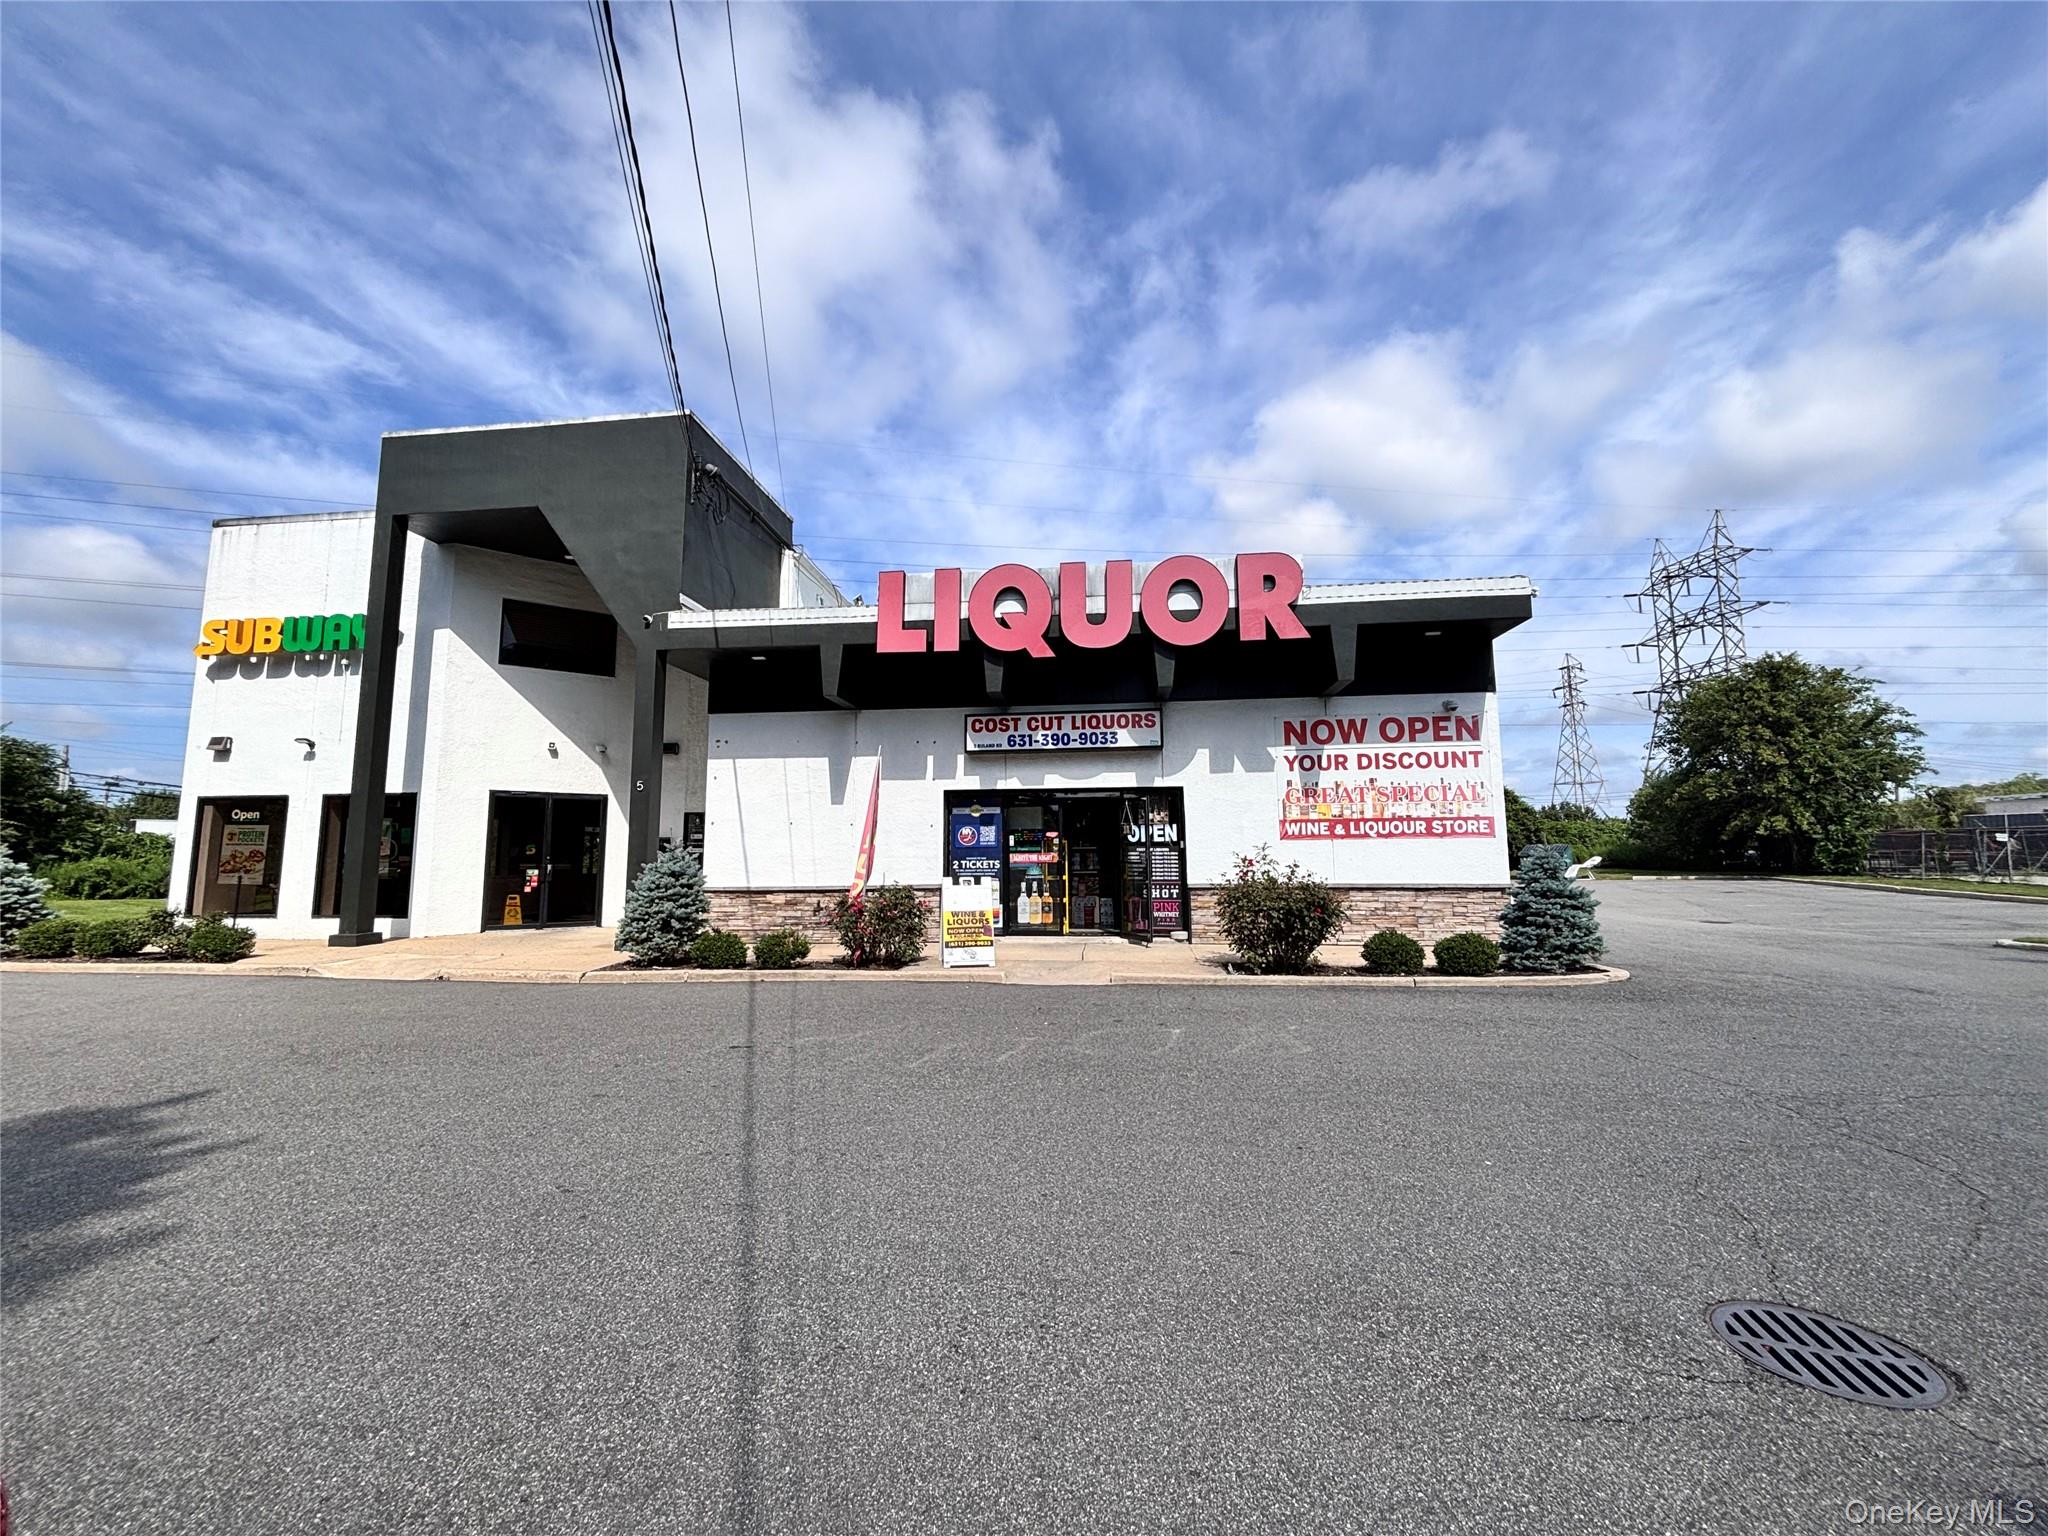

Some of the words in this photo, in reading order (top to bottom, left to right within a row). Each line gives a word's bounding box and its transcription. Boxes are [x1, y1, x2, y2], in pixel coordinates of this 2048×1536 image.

[876, 552, 1311, 658] LIQUOR
[971, 717, 1021, 733] COST
[1027, 716, 1065, 732] CUT
[1071, 713, 1156, 730] LIQUORS
[1283, 718, 1368, 746] NOW
[1379, 715, 1480, 743] OPEN
[1007, 731, 1118, 747] 631-390-9033
[1284, 754, 1348, 772] YOUR
[1357, 751, 1483, 770] DISCOUNT
[637, 780, 644, 791] 5
[1285, 784, 1370, 804] GREAT
[1376, 783, 1485, 803] SPECIAL
[231, 809, 260, 821] Open
[1127, 823, 1178, 842] OPEN
[1286, 822, 1330, 836] WINE
[1335, 823, 1346, 835] &
[1350, 821, 1427, 837] LIQUOUR
[1432, 820, 1490, 834] STORE
[952, 860, 959, 869] 2
[960, 860, 1000, 869] TICKETS
[1153, 902, 1179, 912] PINK
[947, 918, 990, 926] LIQUORS
